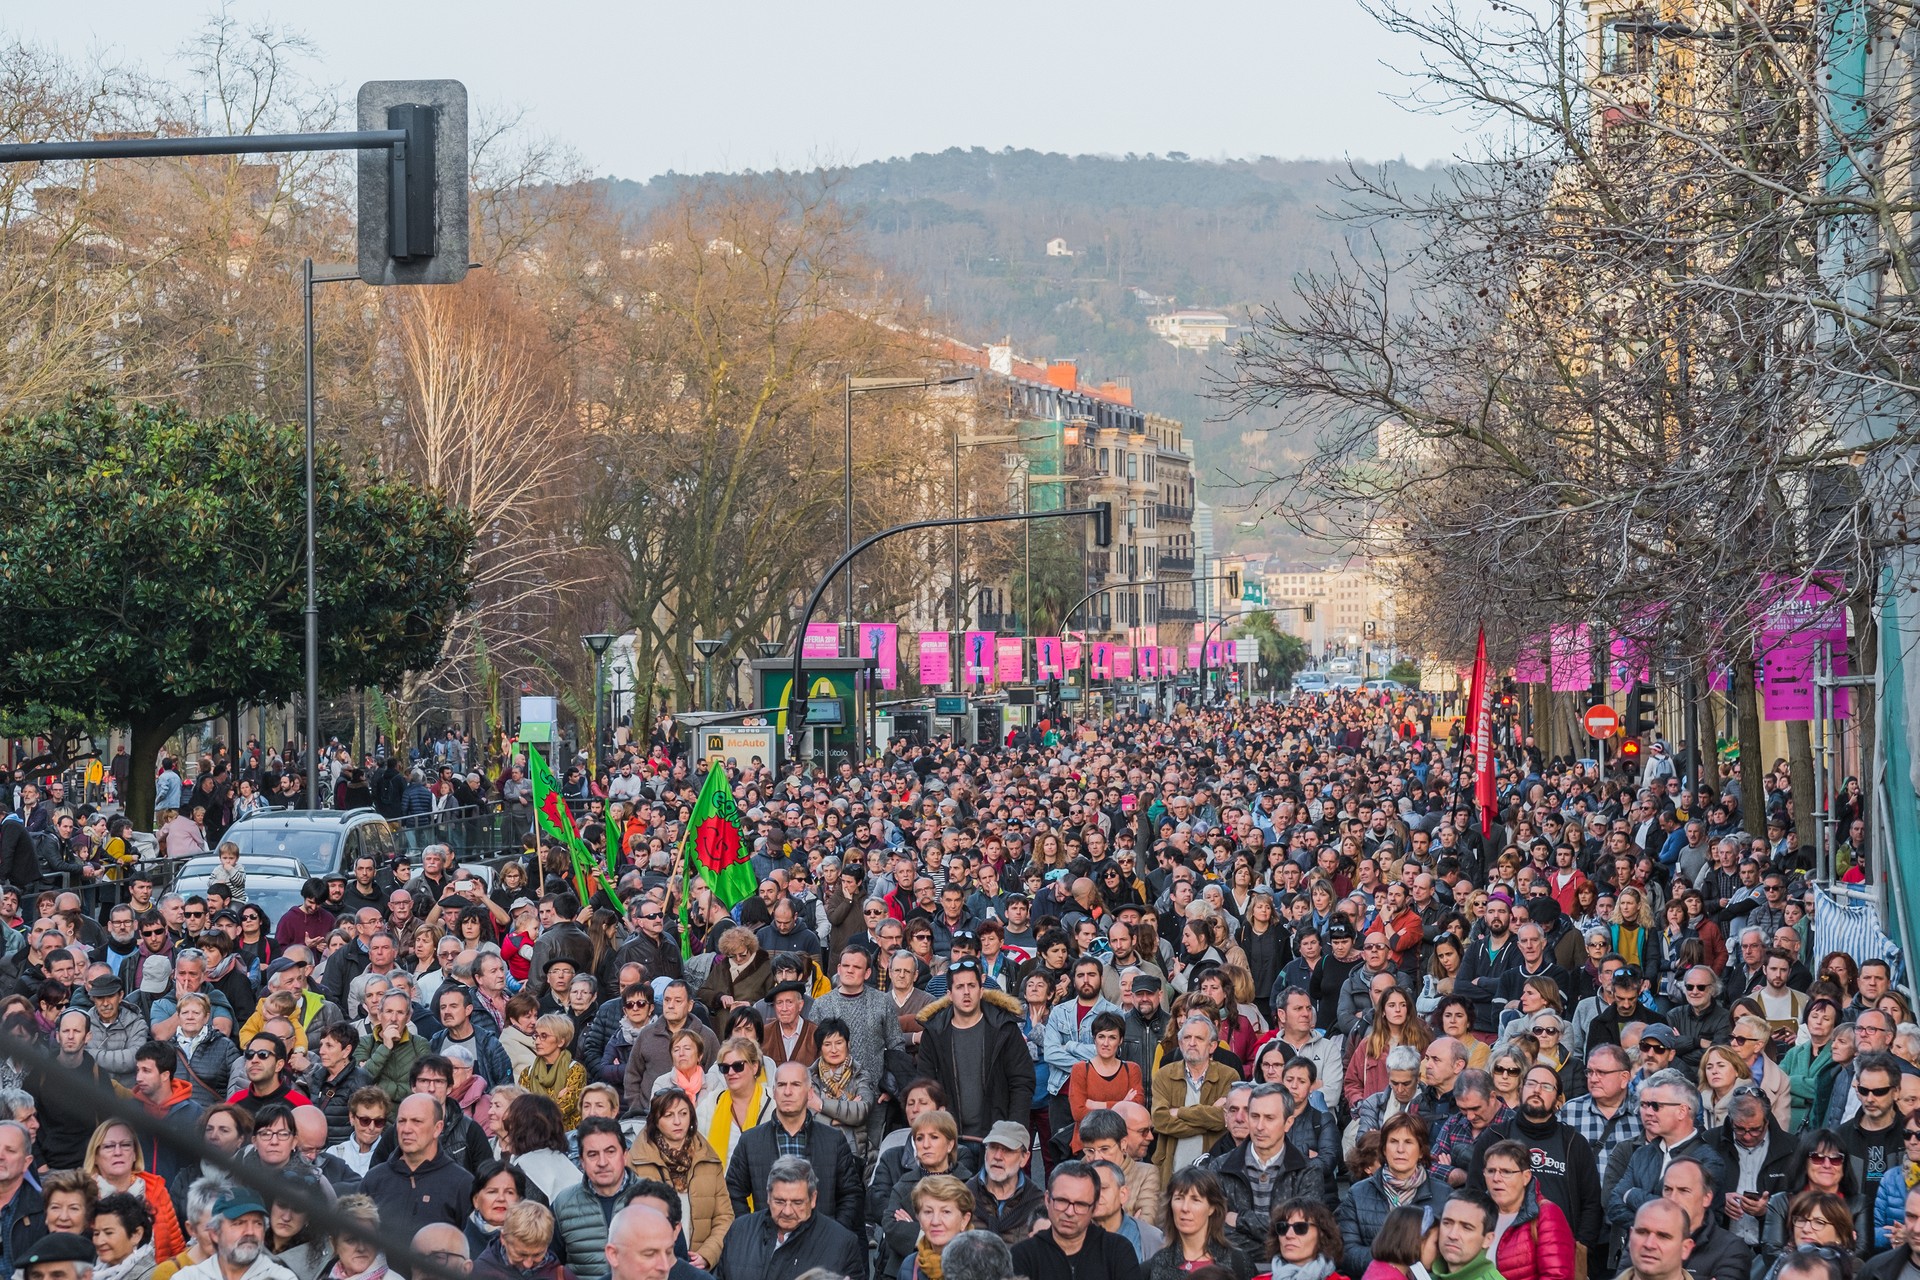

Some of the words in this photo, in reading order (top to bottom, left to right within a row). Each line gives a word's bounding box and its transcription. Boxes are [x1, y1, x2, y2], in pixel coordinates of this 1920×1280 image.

[1365, 622, 1374, 635] P
[727, 738, 766, 748] McAuto
[814, 748, 849, 757] Disútalo
